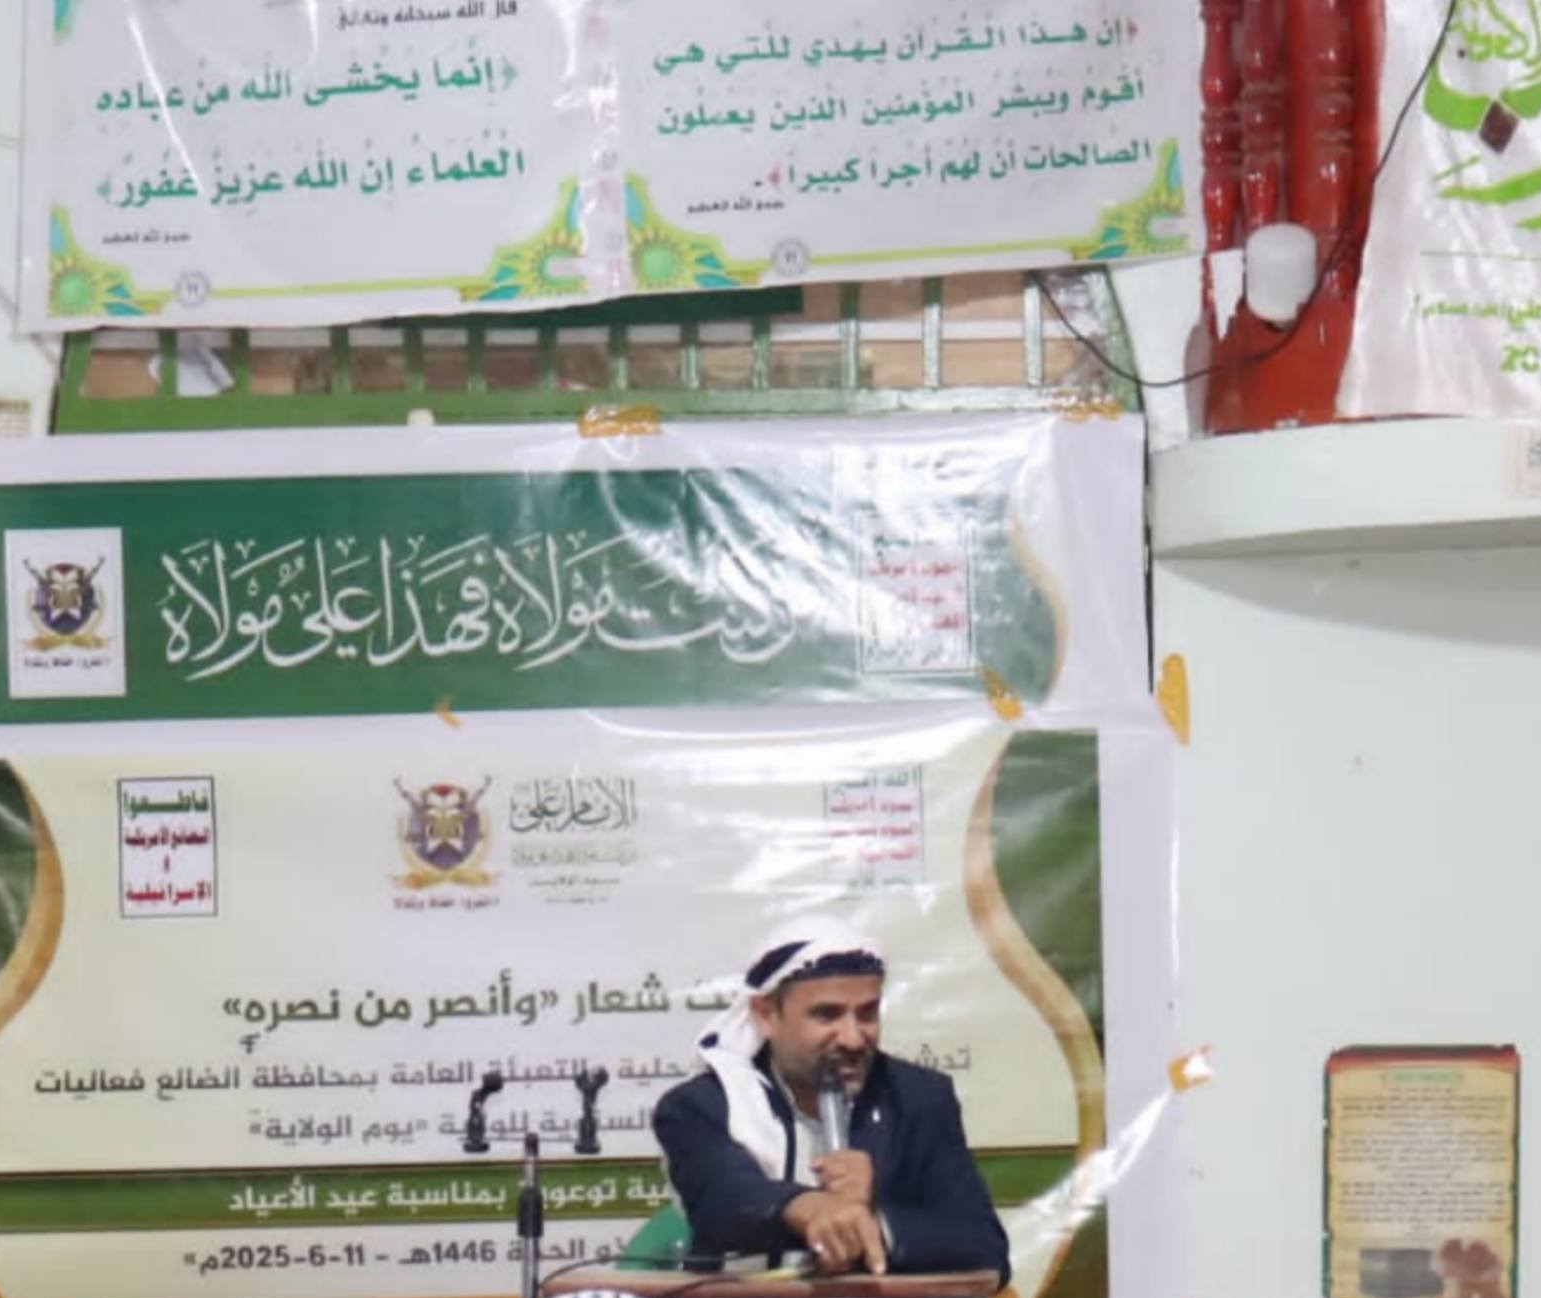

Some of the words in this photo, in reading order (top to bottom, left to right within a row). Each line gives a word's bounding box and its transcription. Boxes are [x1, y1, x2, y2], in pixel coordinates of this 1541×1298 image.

[193, 78, 230, 116] من
[240, 62, 292, 100] الله
[293, 152, 348, 190] الله
[354, 989, 412, 1028] من
[571, 972, 671, 1025] شعار
[34, 1067, 146, 1101] فعاليات
[156, 1066, 241, 1101] الضالع
[251, 1063, 379, 1094] بمحافظة
[390, 1058, 475, 1086] العامة
[228, 1174, 317, 1217] الأعياد
[324, 1187, 379, 1217] عيد
[386, 1179, 506, 1215] بمناسبة
